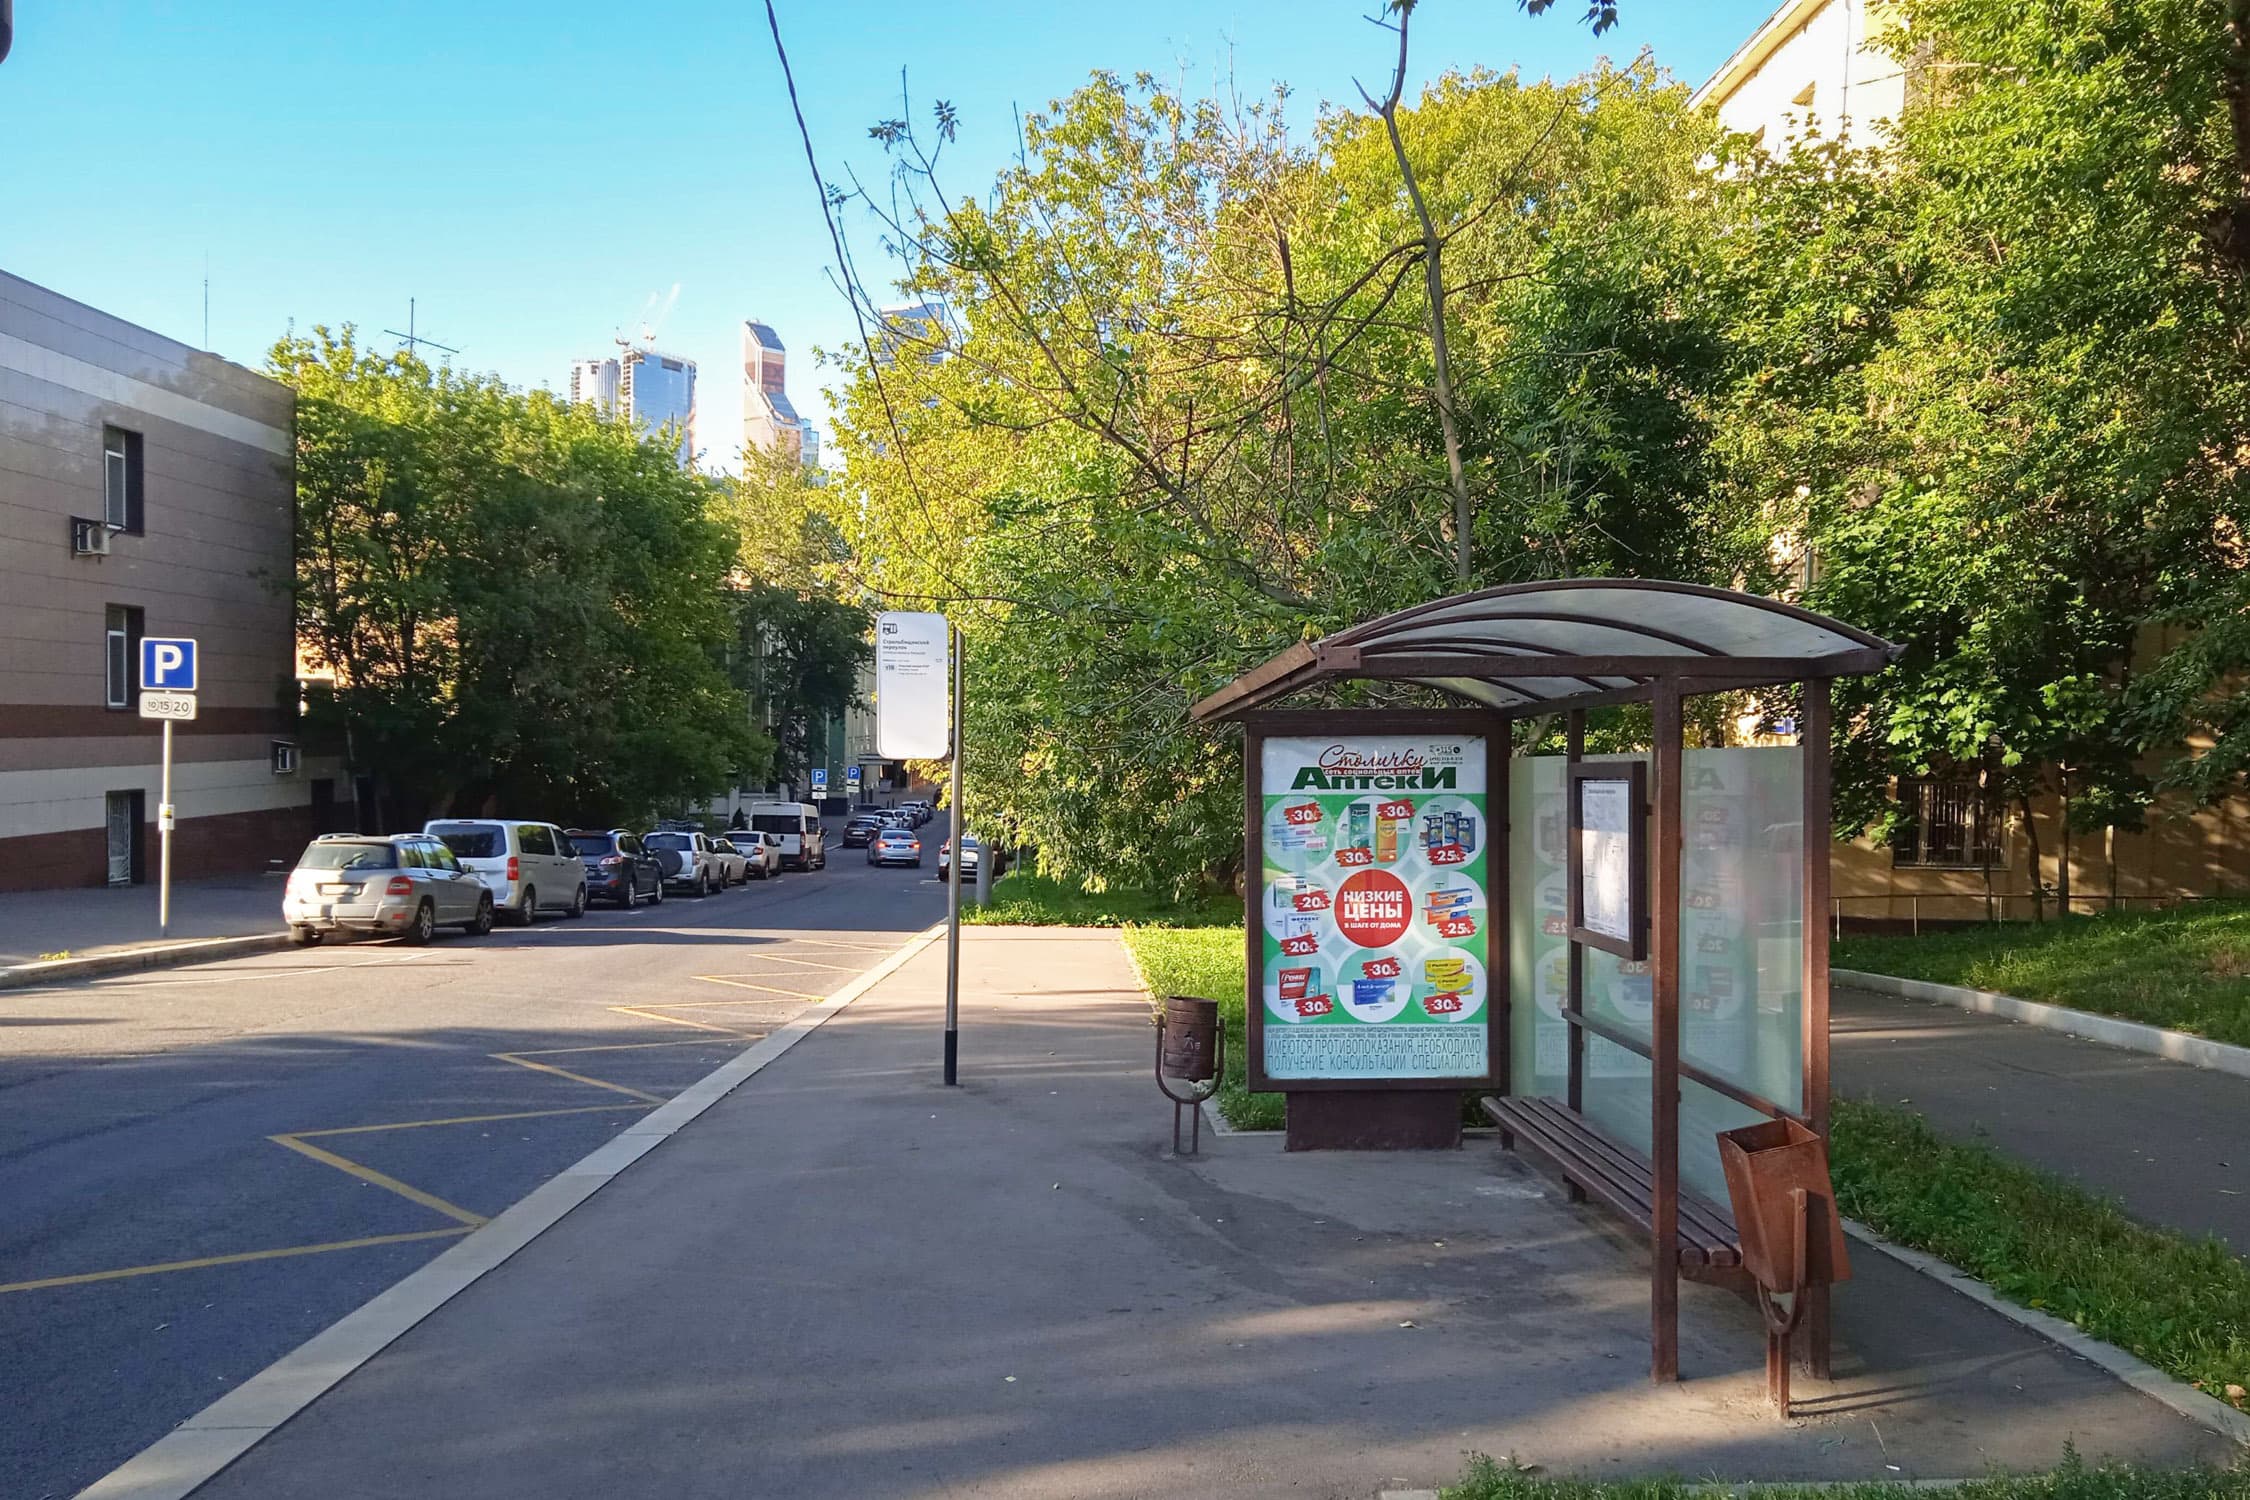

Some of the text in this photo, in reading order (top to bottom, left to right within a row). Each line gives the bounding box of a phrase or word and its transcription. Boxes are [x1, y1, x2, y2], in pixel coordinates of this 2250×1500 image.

[155, 644, 183, 684] P
[147, 701, 189, 713] 10 15 20
[1319, 744, 1428, 769] Столички
[1343, 768, 1395, 776] социальных
[1396, 768, 1420, 776] аптек
[1343, 890, 1403, 902] НИЗКИЕ
[1344, 903, 1403, 921] ЦЕНЫ
[1267, 1039, 1312, 1055] ИМЕЮТСЯ
[1417, 1038, 1481, 1054] НЕОБХОДИМО
[1267, 1054, 1481, 1071] ПОЛУЧЕНИЕ КОНСУЛЬТАЦИИ СПЕЦИАЛИСТА
